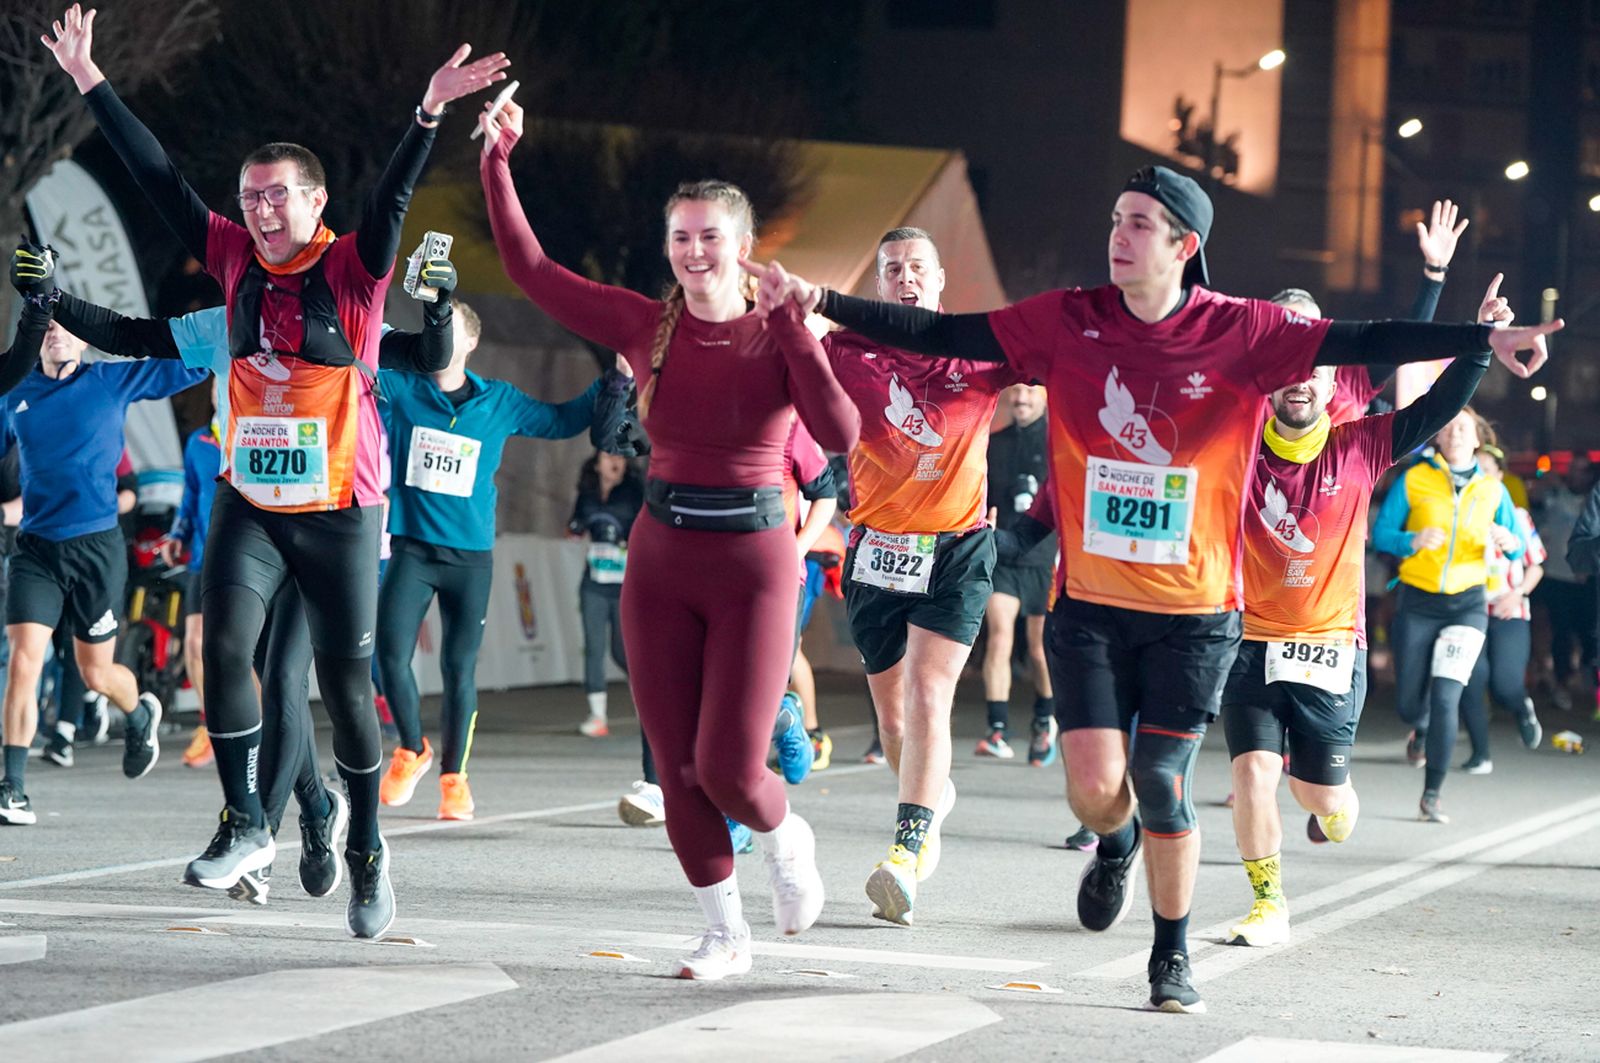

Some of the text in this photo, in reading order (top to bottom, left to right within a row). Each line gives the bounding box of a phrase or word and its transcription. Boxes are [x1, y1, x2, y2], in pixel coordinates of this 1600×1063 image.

[251, 426, 288, 436] NOCHE DE
[902, 414, 924, 436] 43
[1119, 421, 1147, 449] 43
[241, 437, 257, 447] SAN
[249, 449, 307, 475] 8270
[424, 452, 461, 475] 5151
[1097, 481, 1116, 492] SAN
[1110, 472, 1155, 486] NOCHE DE
[1106, 495, 1171, 530] 8291
[1275, 519, 1296, 541] 43
[870, 548, 923, 577] 3922
[1282, 641, 1339, 668] 3923
[896, 819, 928, 830] OVE
